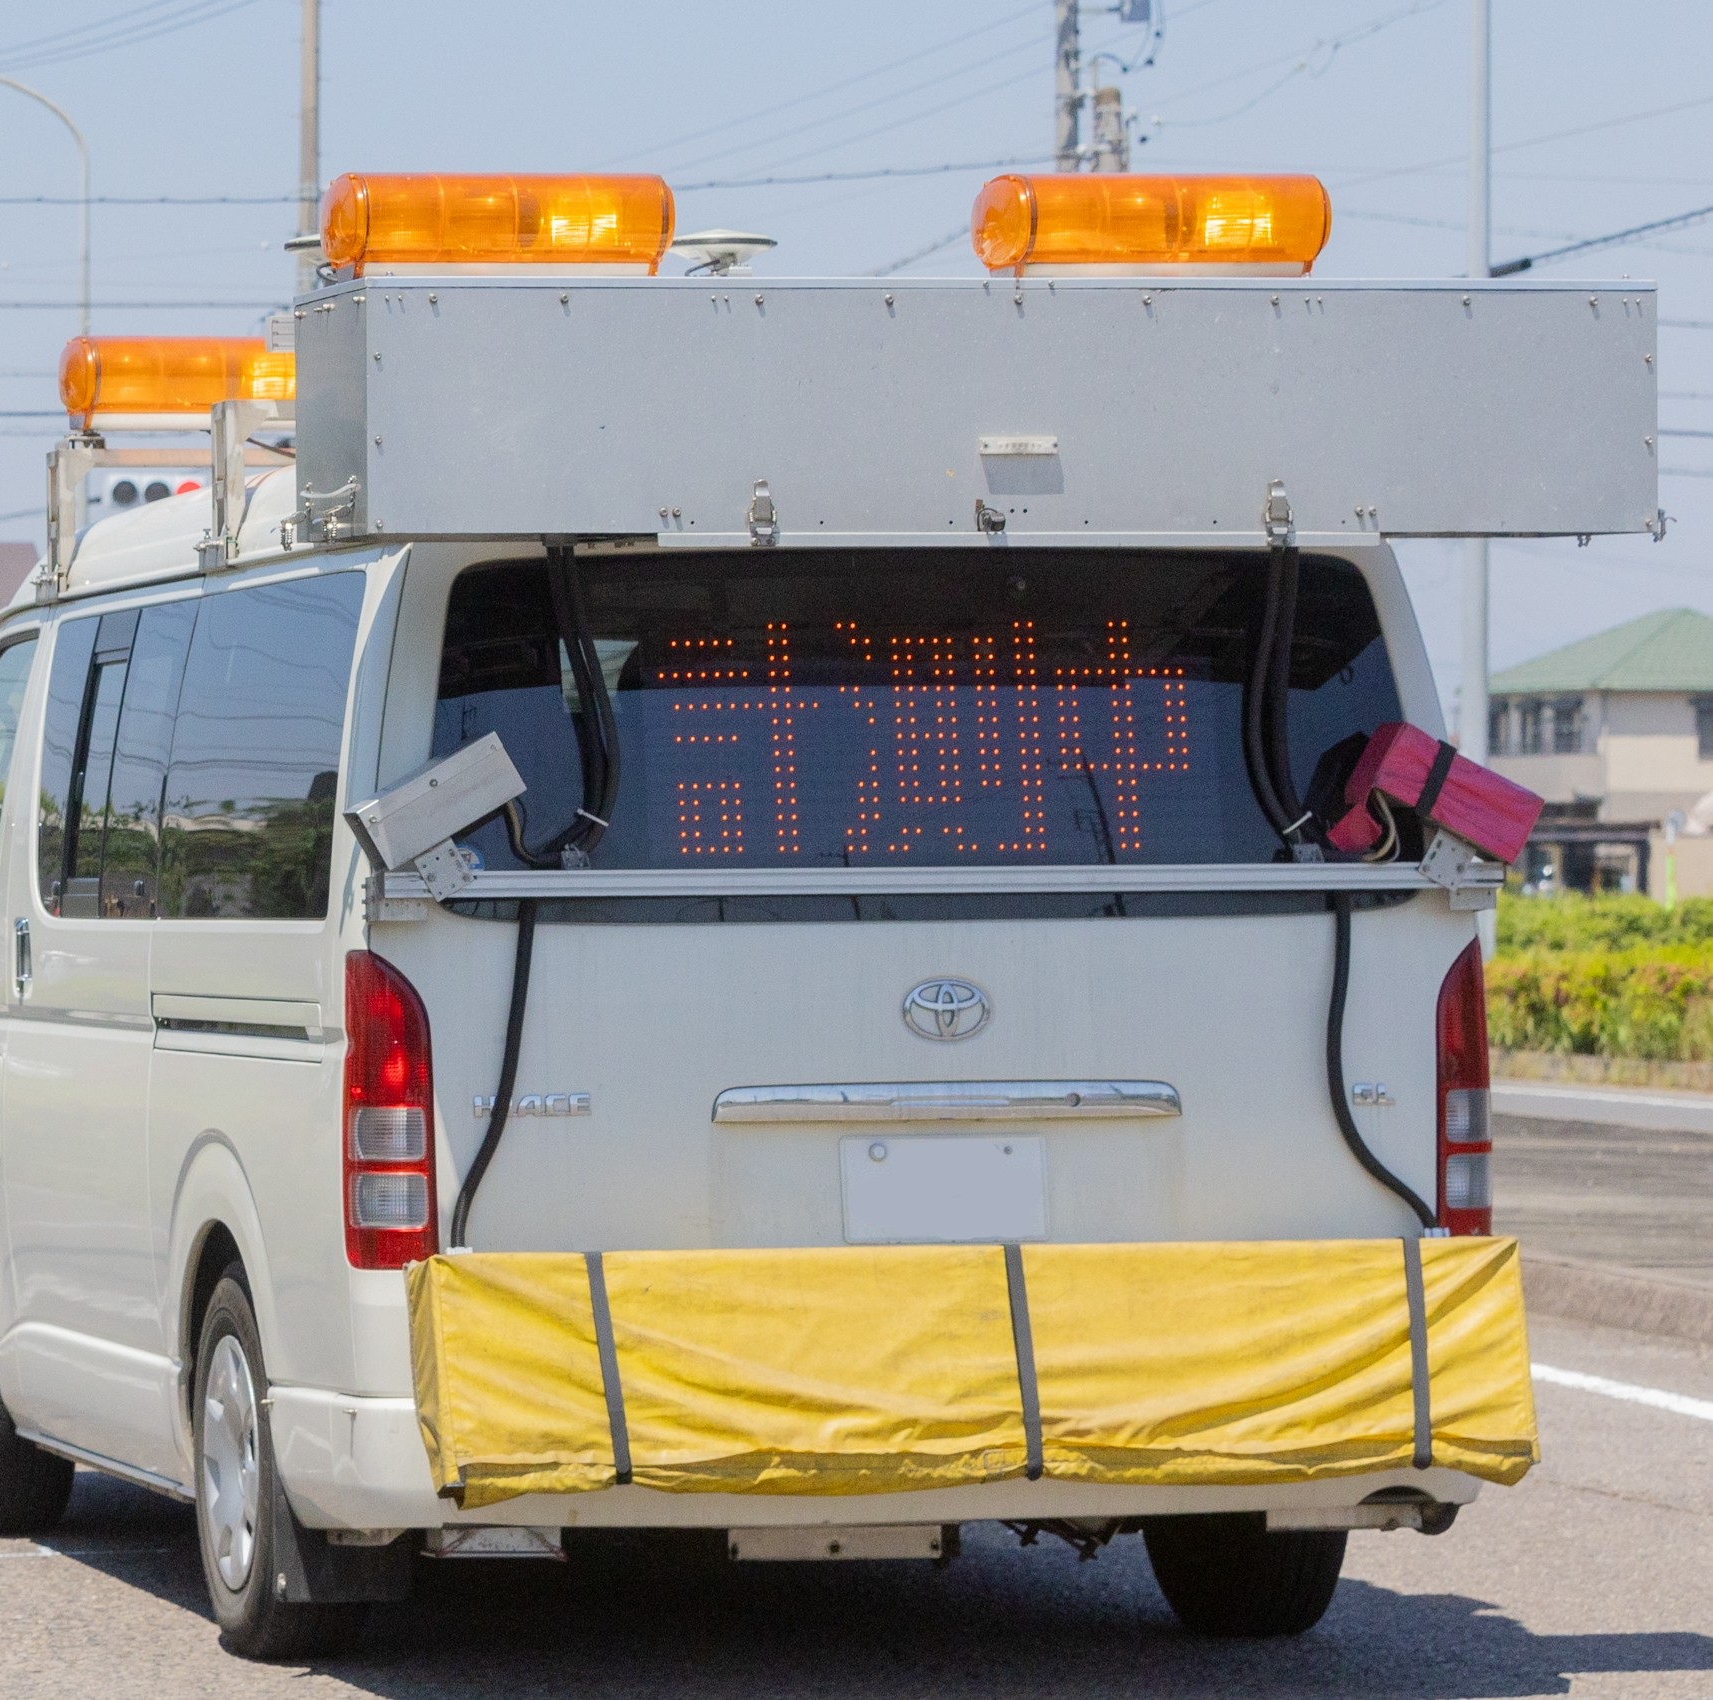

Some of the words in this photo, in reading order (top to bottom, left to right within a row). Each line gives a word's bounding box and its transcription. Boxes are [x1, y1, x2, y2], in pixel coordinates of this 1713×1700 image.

[657, 619, 1191, 853] 計測中
[473, 1092, 591, 1118] HACE
